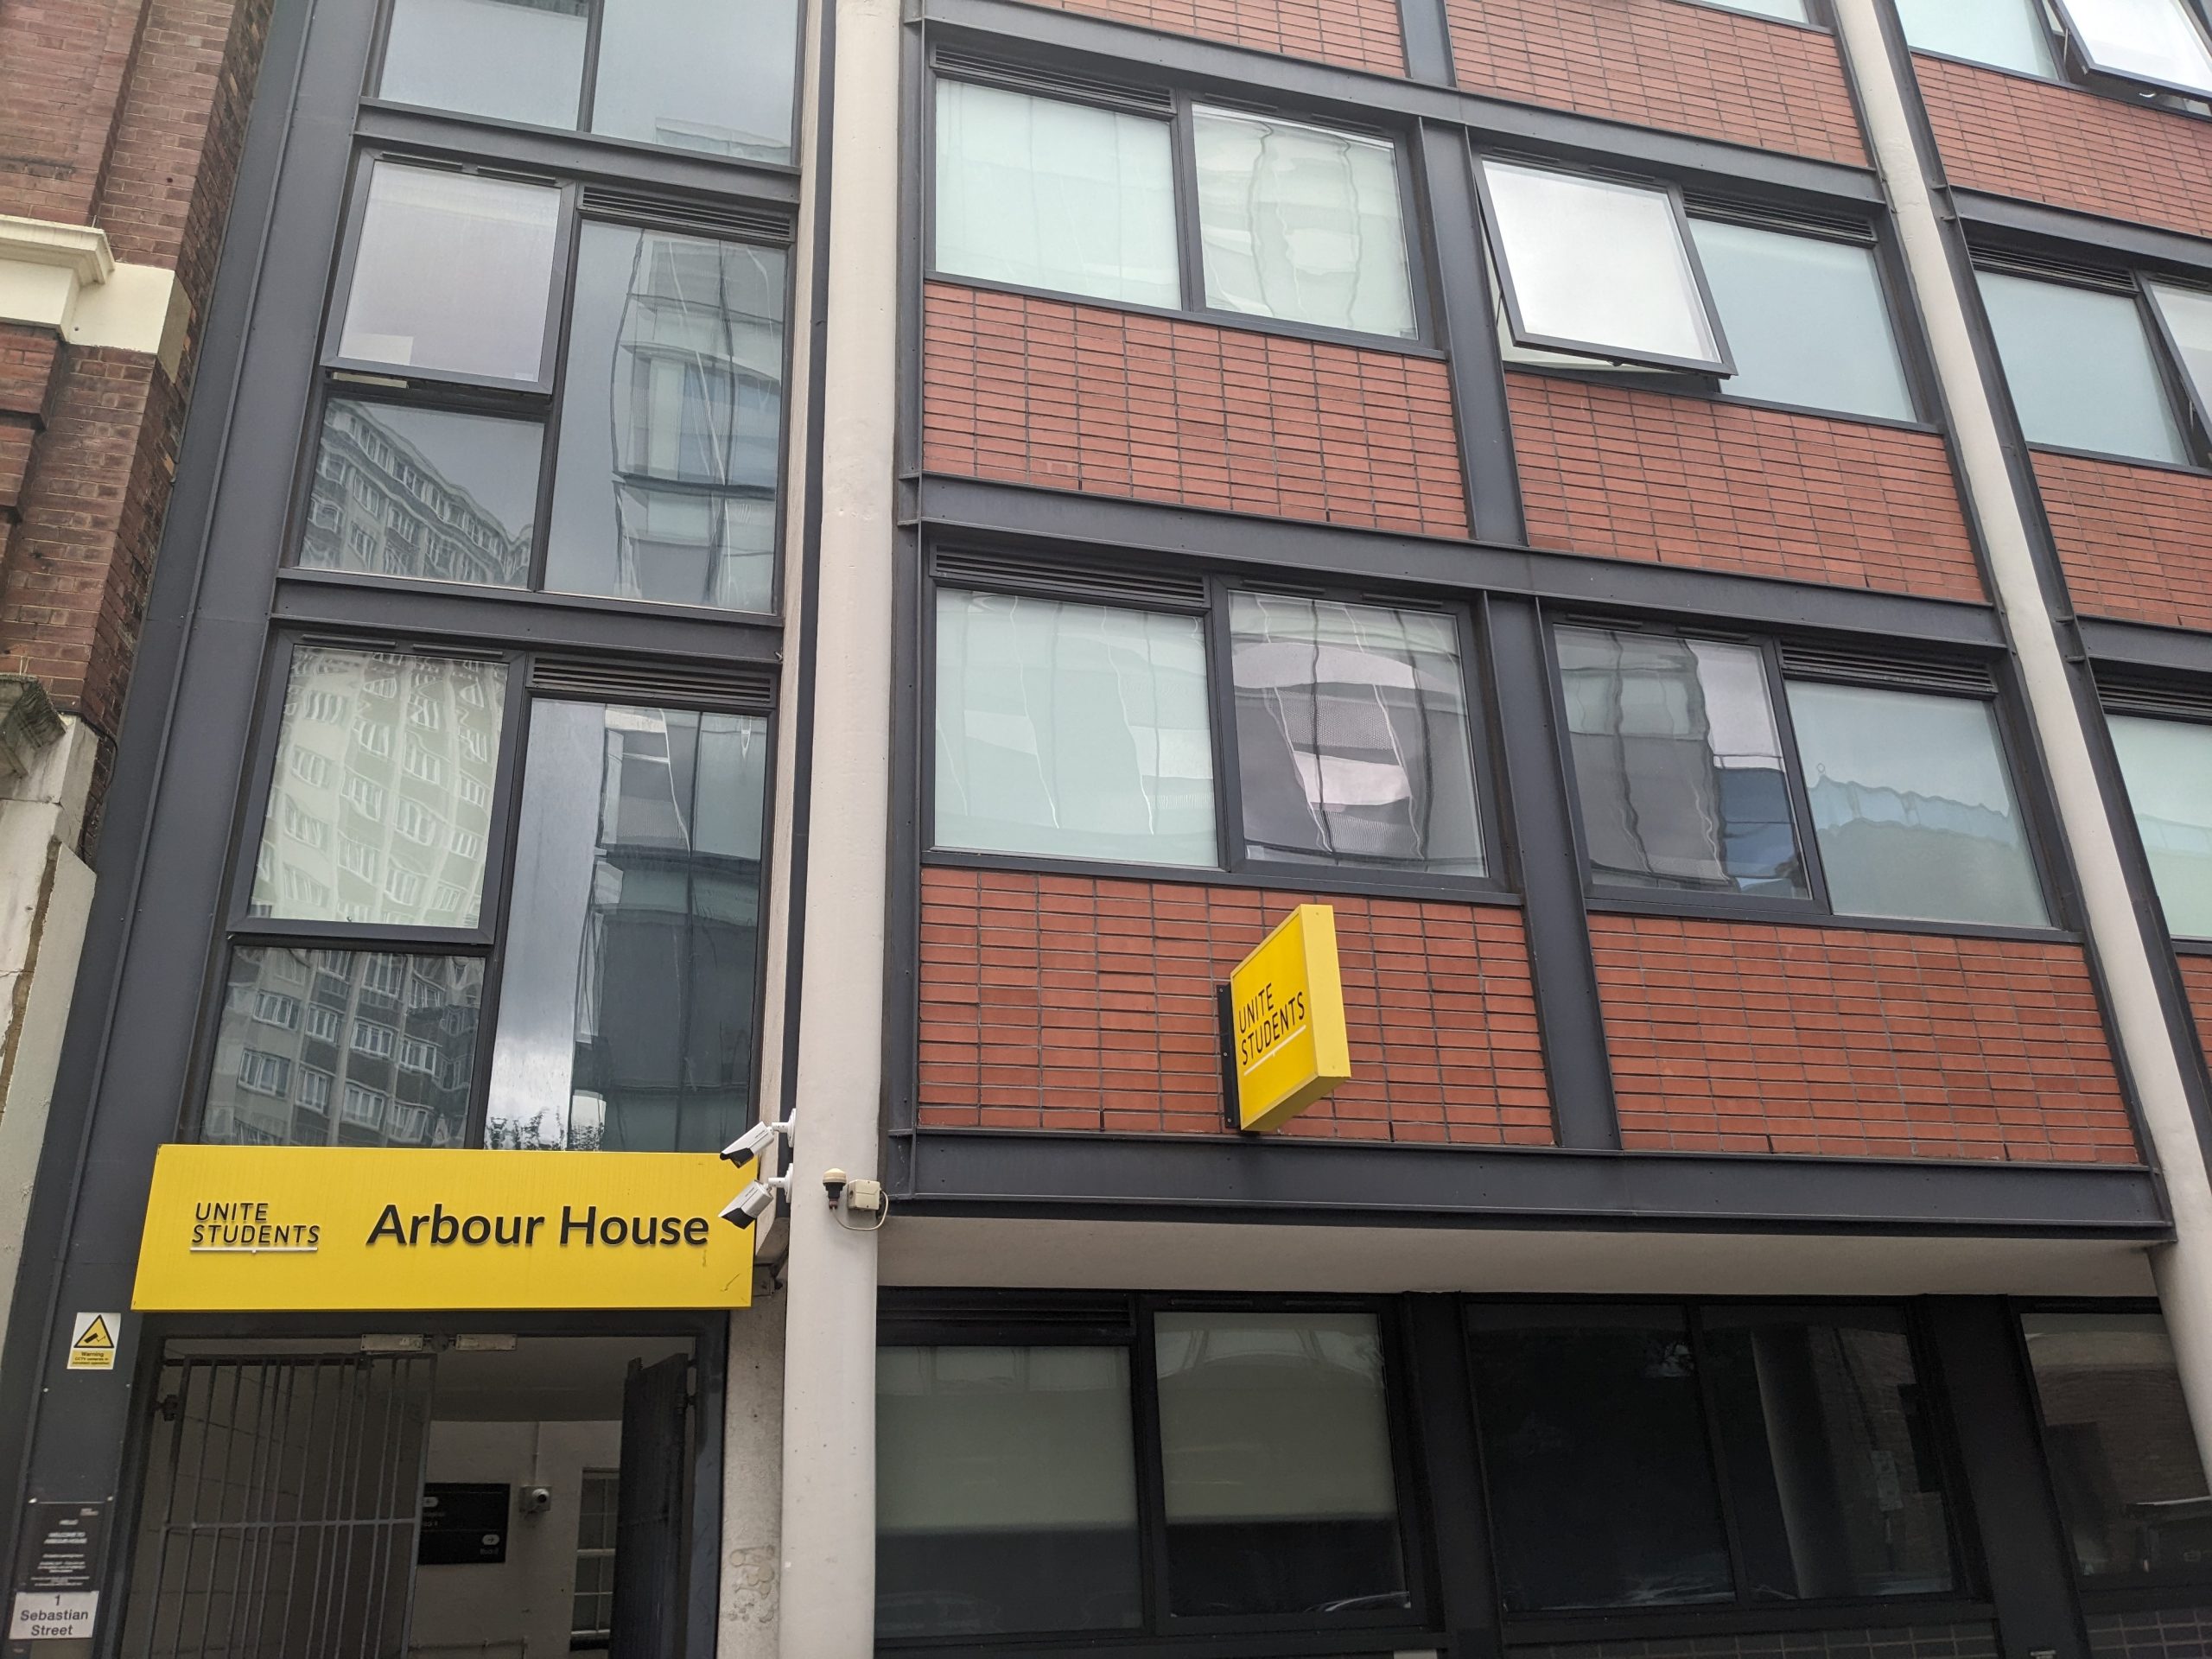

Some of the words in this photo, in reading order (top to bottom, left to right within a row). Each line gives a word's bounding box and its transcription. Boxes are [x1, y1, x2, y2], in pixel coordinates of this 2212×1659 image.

[1239, 982, 1274, 1034] UNITE
[1241, 991, 1306, 1065] STUDENTS
[195, 1202, 269, 1221] UNITE
[192, 1224, 321, 1243] STUDENTS
[365, 1204, 545, 1245] Arbour
[560, 1205, 709, 1245] House
[55, 1594, 60, 1606] 1
[20, 1610, 89, 1621] Sebastian
[31, 1624, 73, 1636] Street
